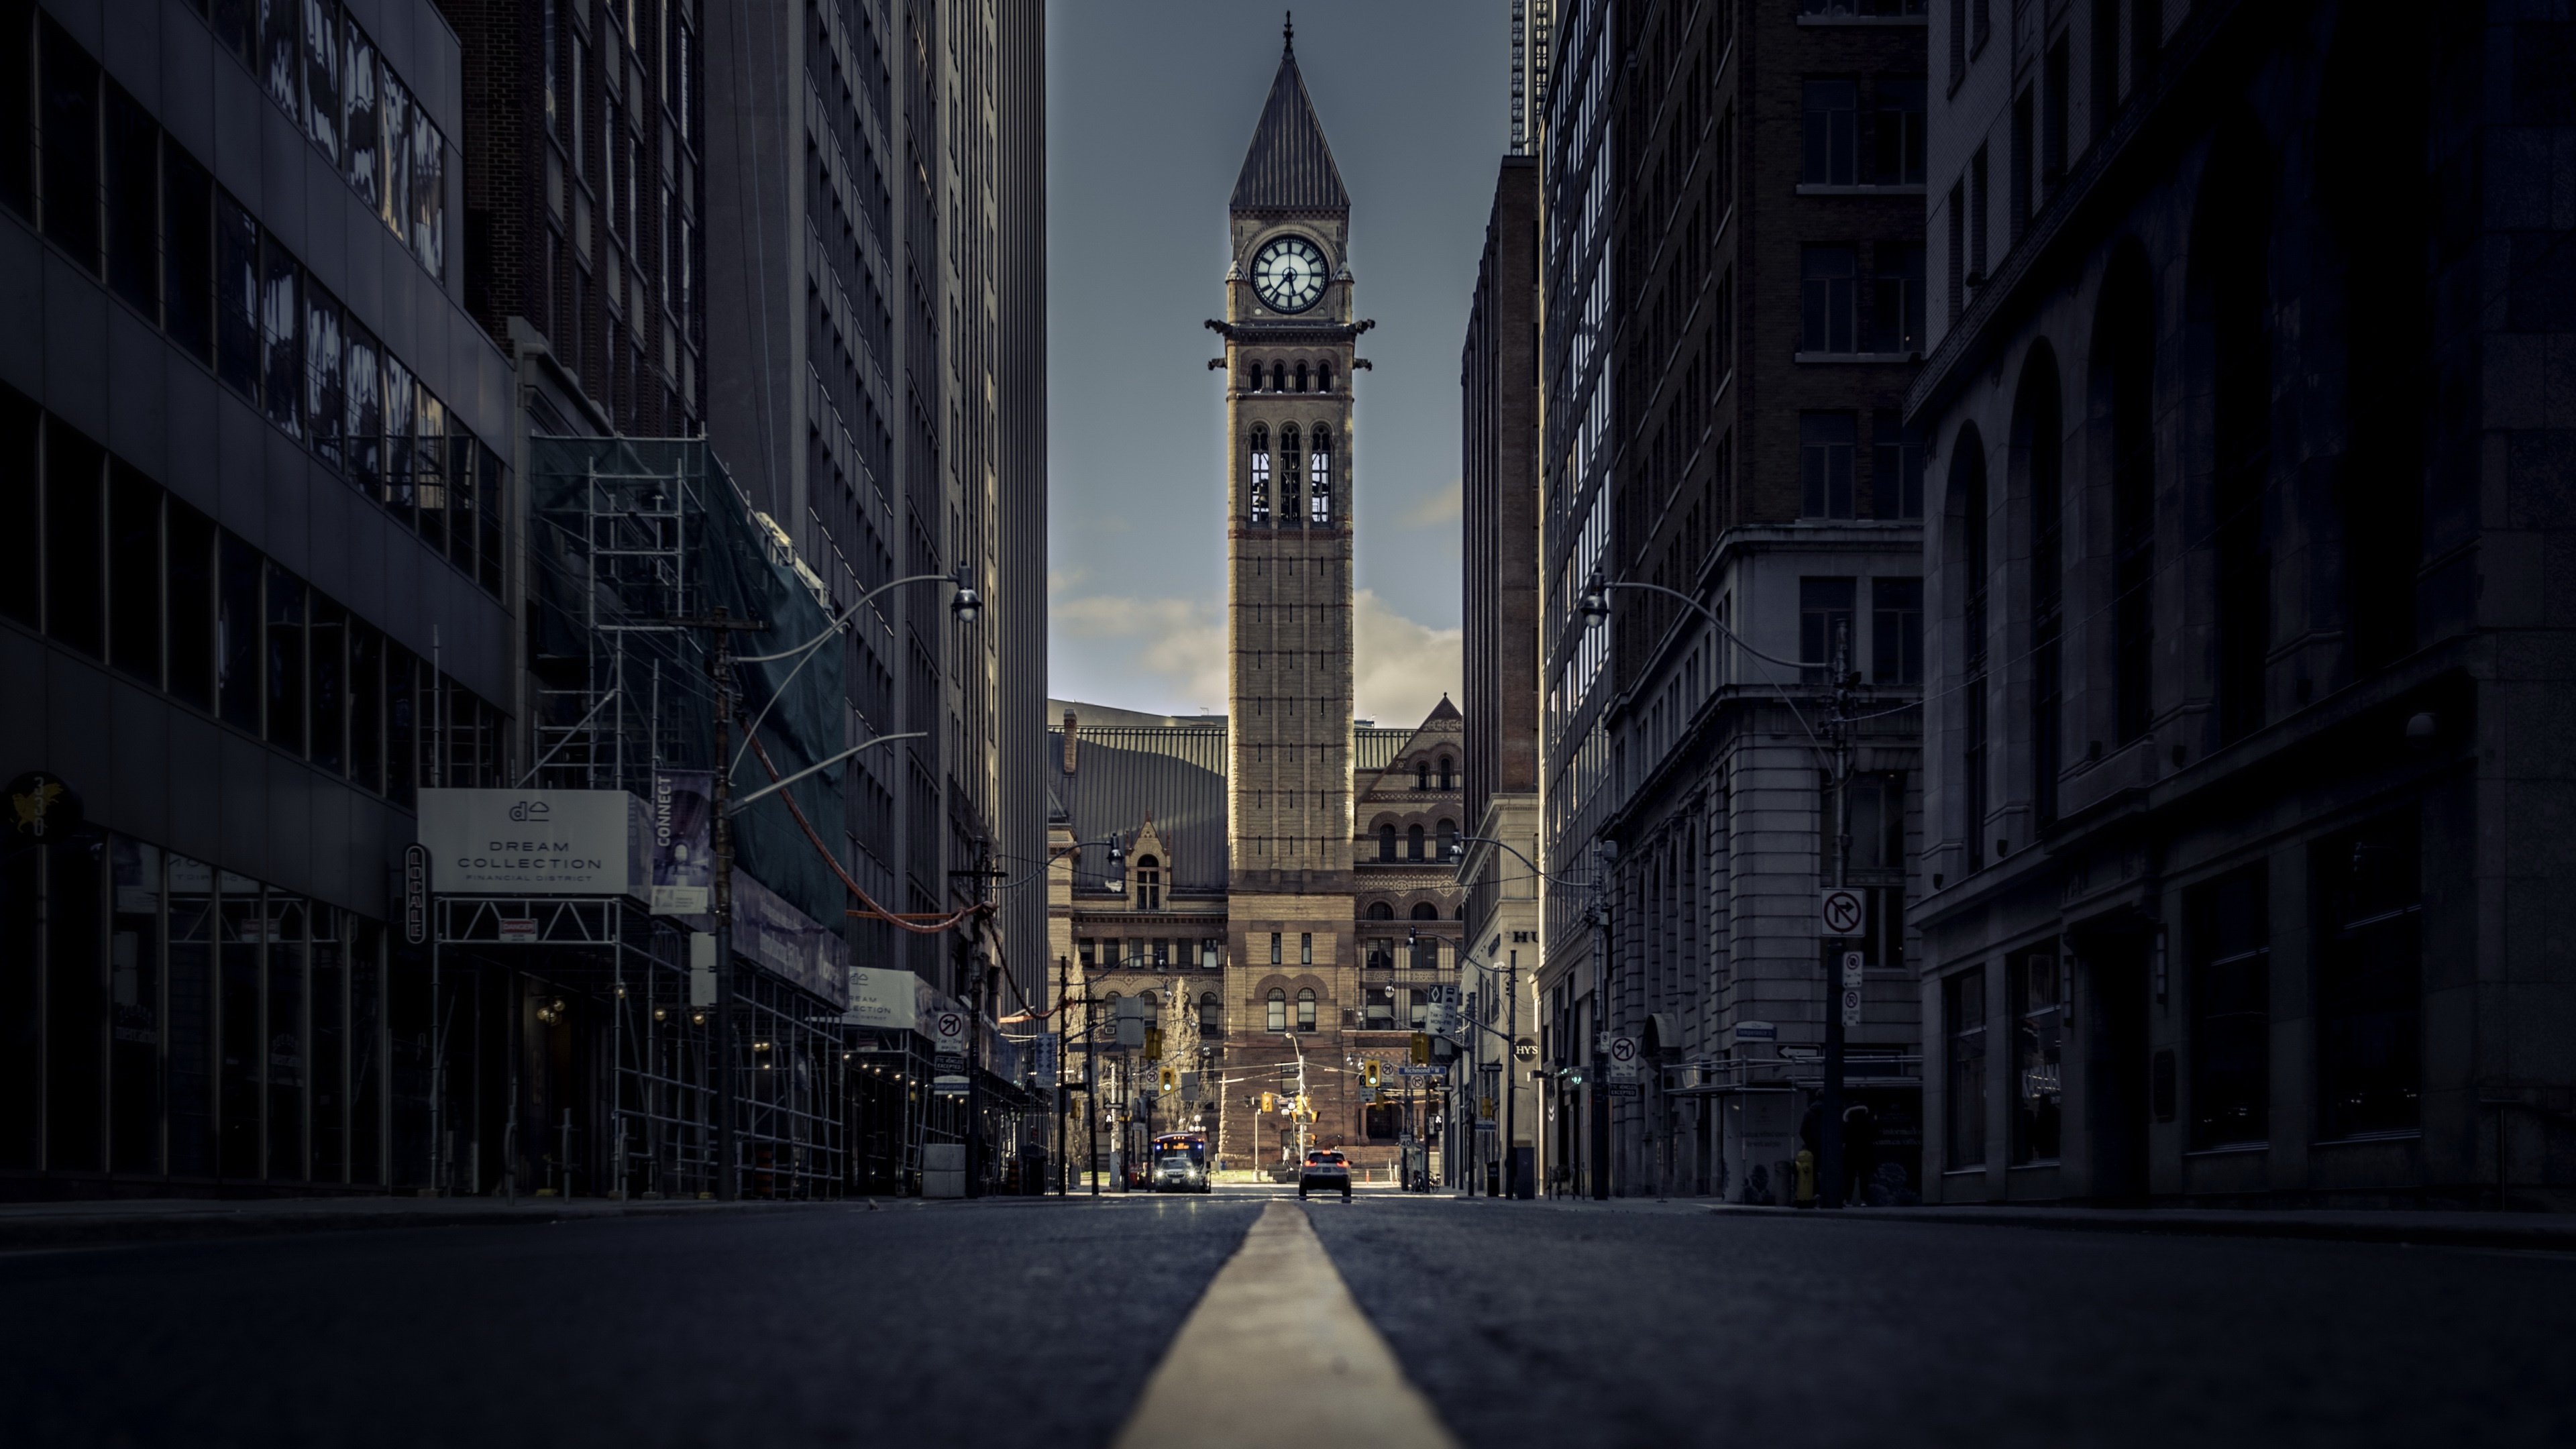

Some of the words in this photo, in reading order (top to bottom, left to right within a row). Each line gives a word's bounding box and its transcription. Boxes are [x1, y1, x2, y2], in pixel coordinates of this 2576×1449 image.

[656, 776, 672, 847] CONNECT
[458, 858, 602, 869] COLLECTION
[489, 841, 570, 852] DREAM
[409, 852, 423, 937] LOCALE
